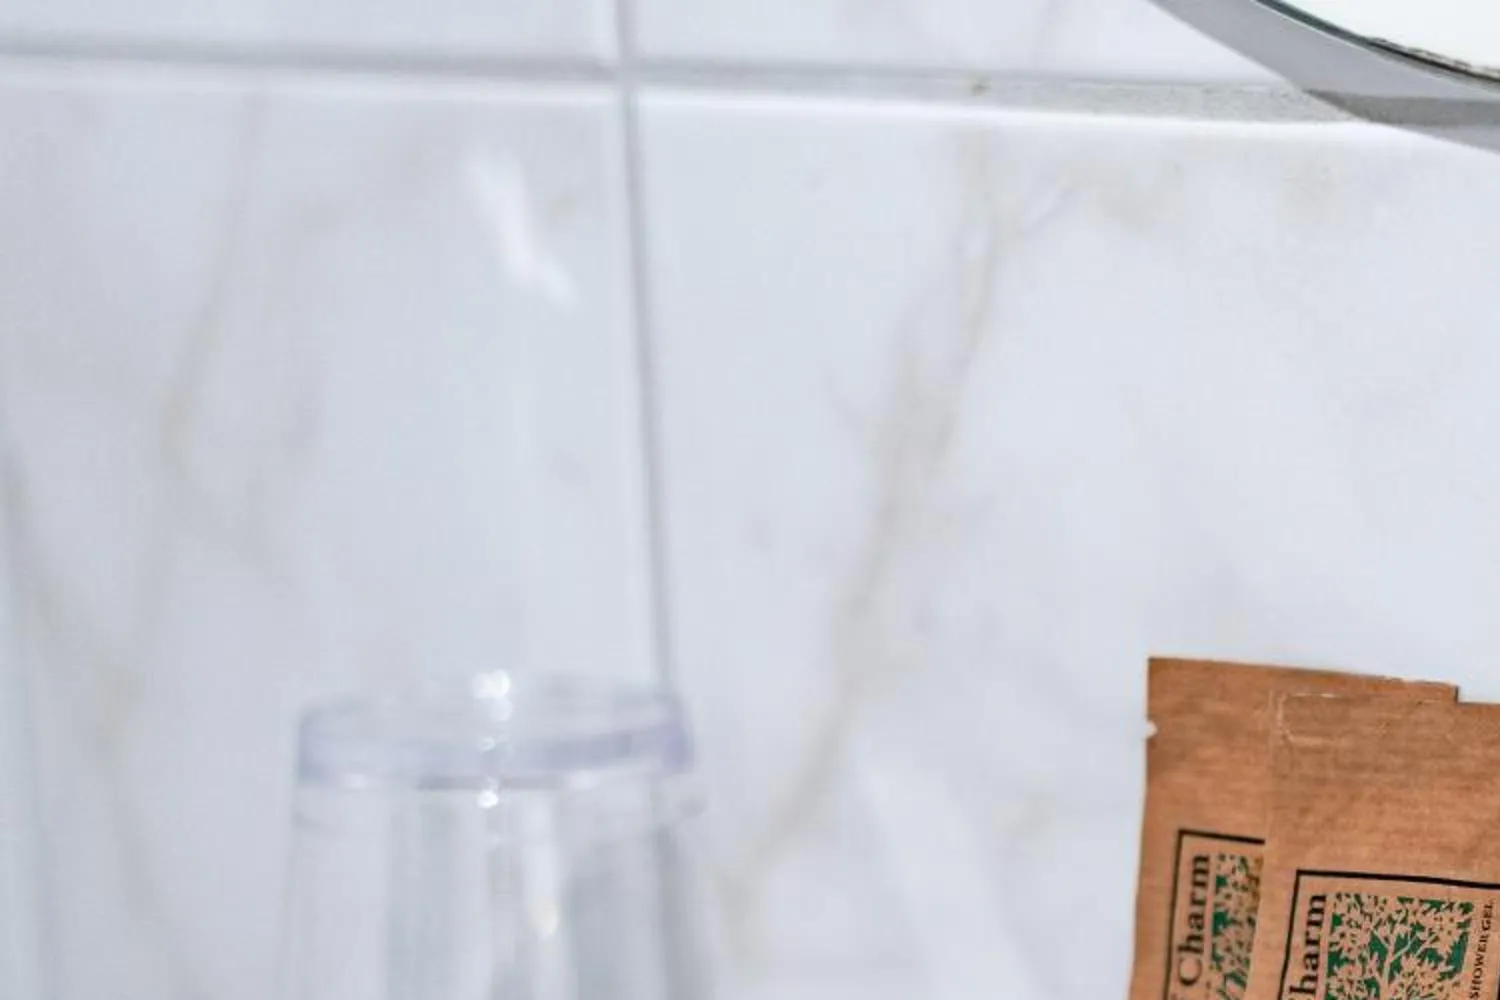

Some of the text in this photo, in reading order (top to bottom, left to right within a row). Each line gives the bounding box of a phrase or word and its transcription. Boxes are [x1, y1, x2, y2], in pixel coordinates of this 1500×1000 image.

[1177, 855, 1210, 986] Charm
[1468, 932, 1490, 999] SHOWER
[1482, 900, 1495, 931] GEL
